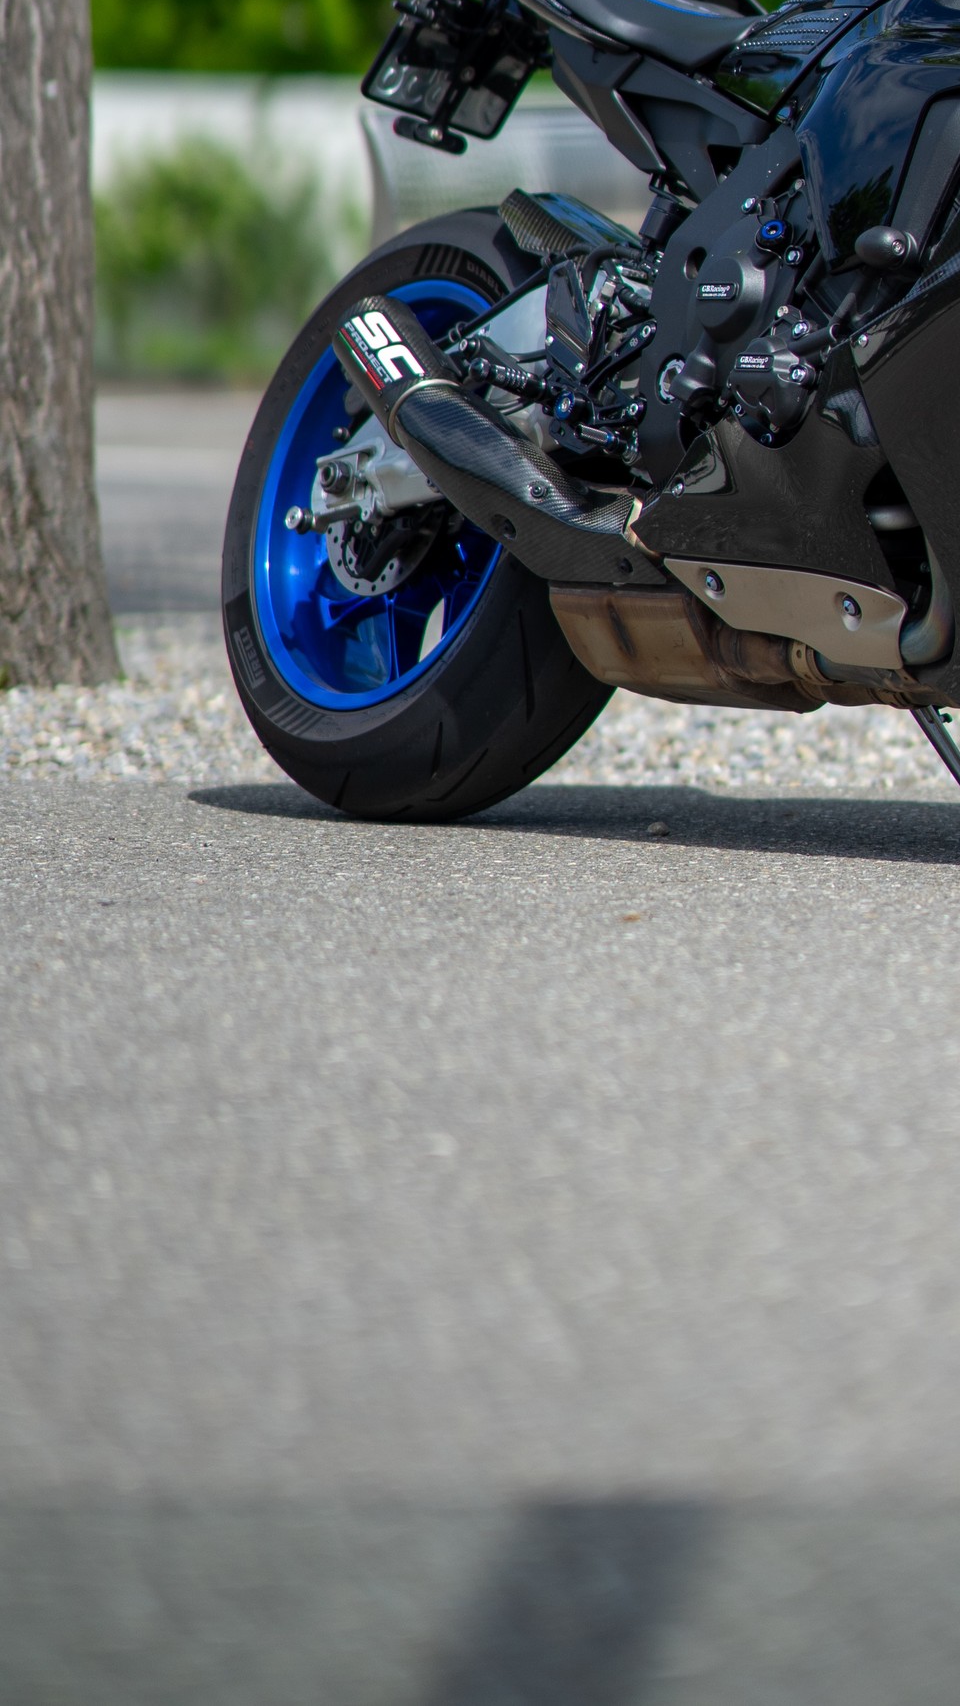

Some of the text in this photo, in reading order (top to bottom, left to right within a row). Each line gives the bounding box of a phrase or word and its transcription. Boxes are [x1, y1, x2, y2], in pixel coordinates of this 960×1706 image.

[344, 321, 392, 383] PROJECT
[351, 311, 425, 381] SC
[233, 625, 266, 689] PIRELLI
